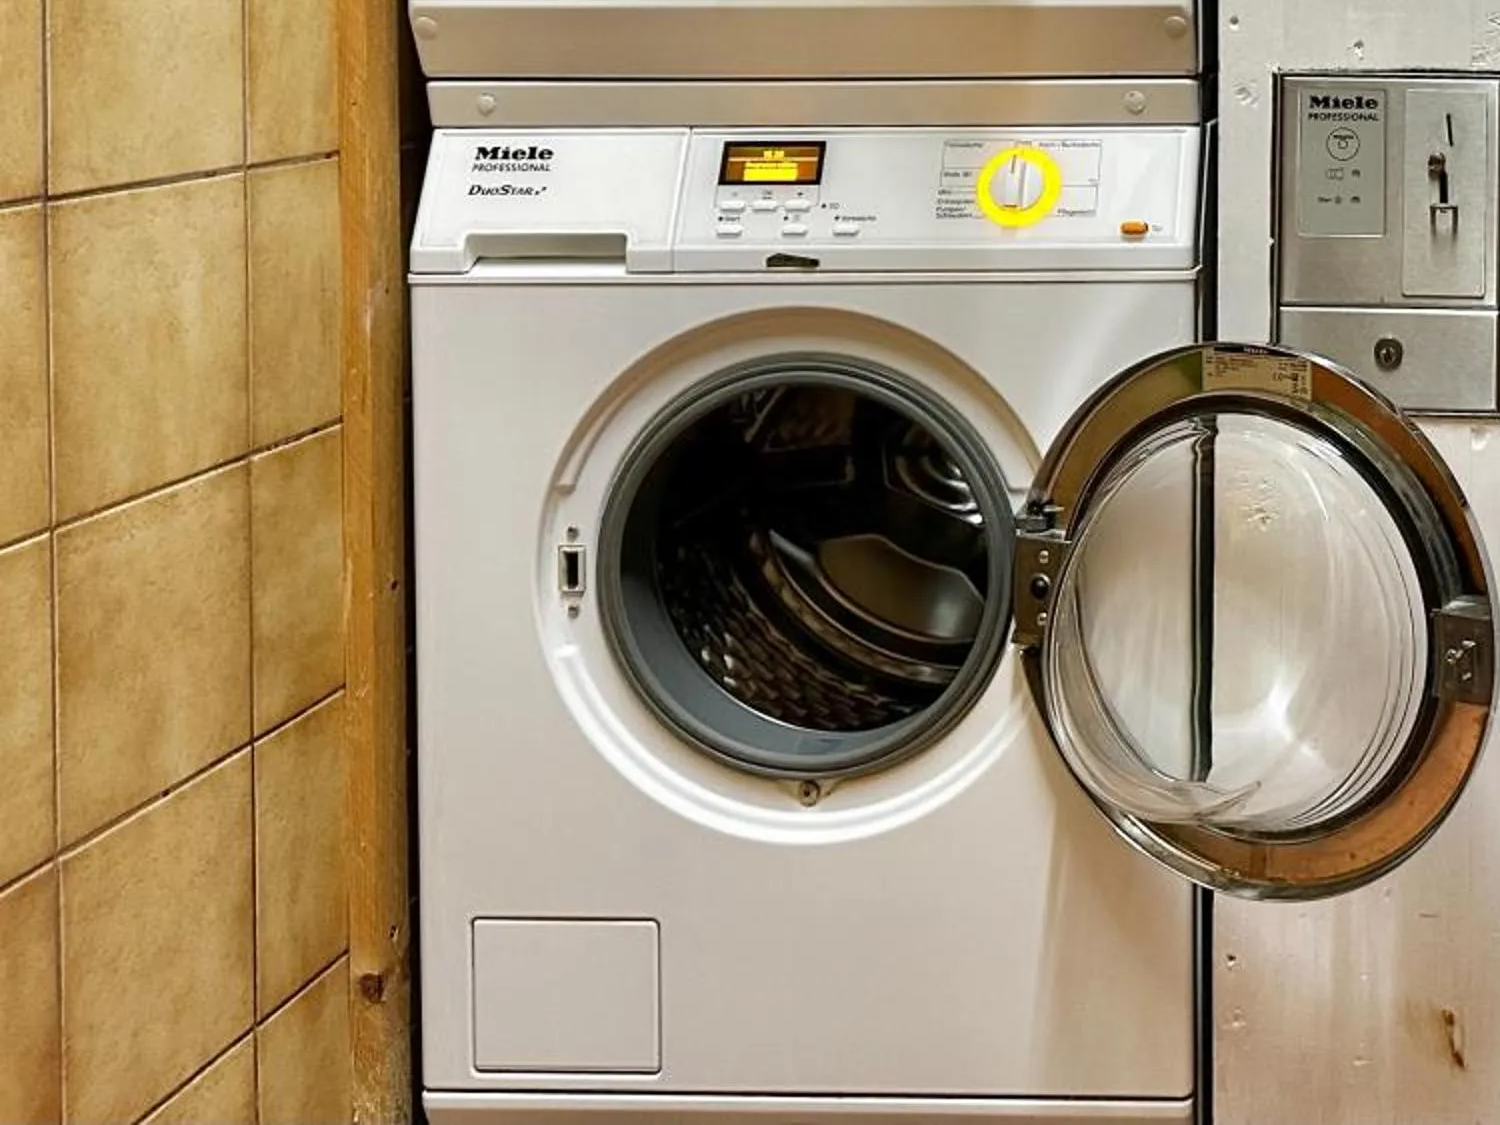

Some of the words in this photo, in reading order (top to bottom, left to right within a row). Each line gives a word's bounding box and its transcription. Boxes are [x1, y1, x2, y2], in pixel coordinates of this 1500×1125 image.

[1309, 95, 1379, 109] Miele
[1308, 113, 1379, 121] PROFESSIONAL
[475, 146, 554, 161] Miele
[471, 162, 551, 172] PROFESSIONAL
